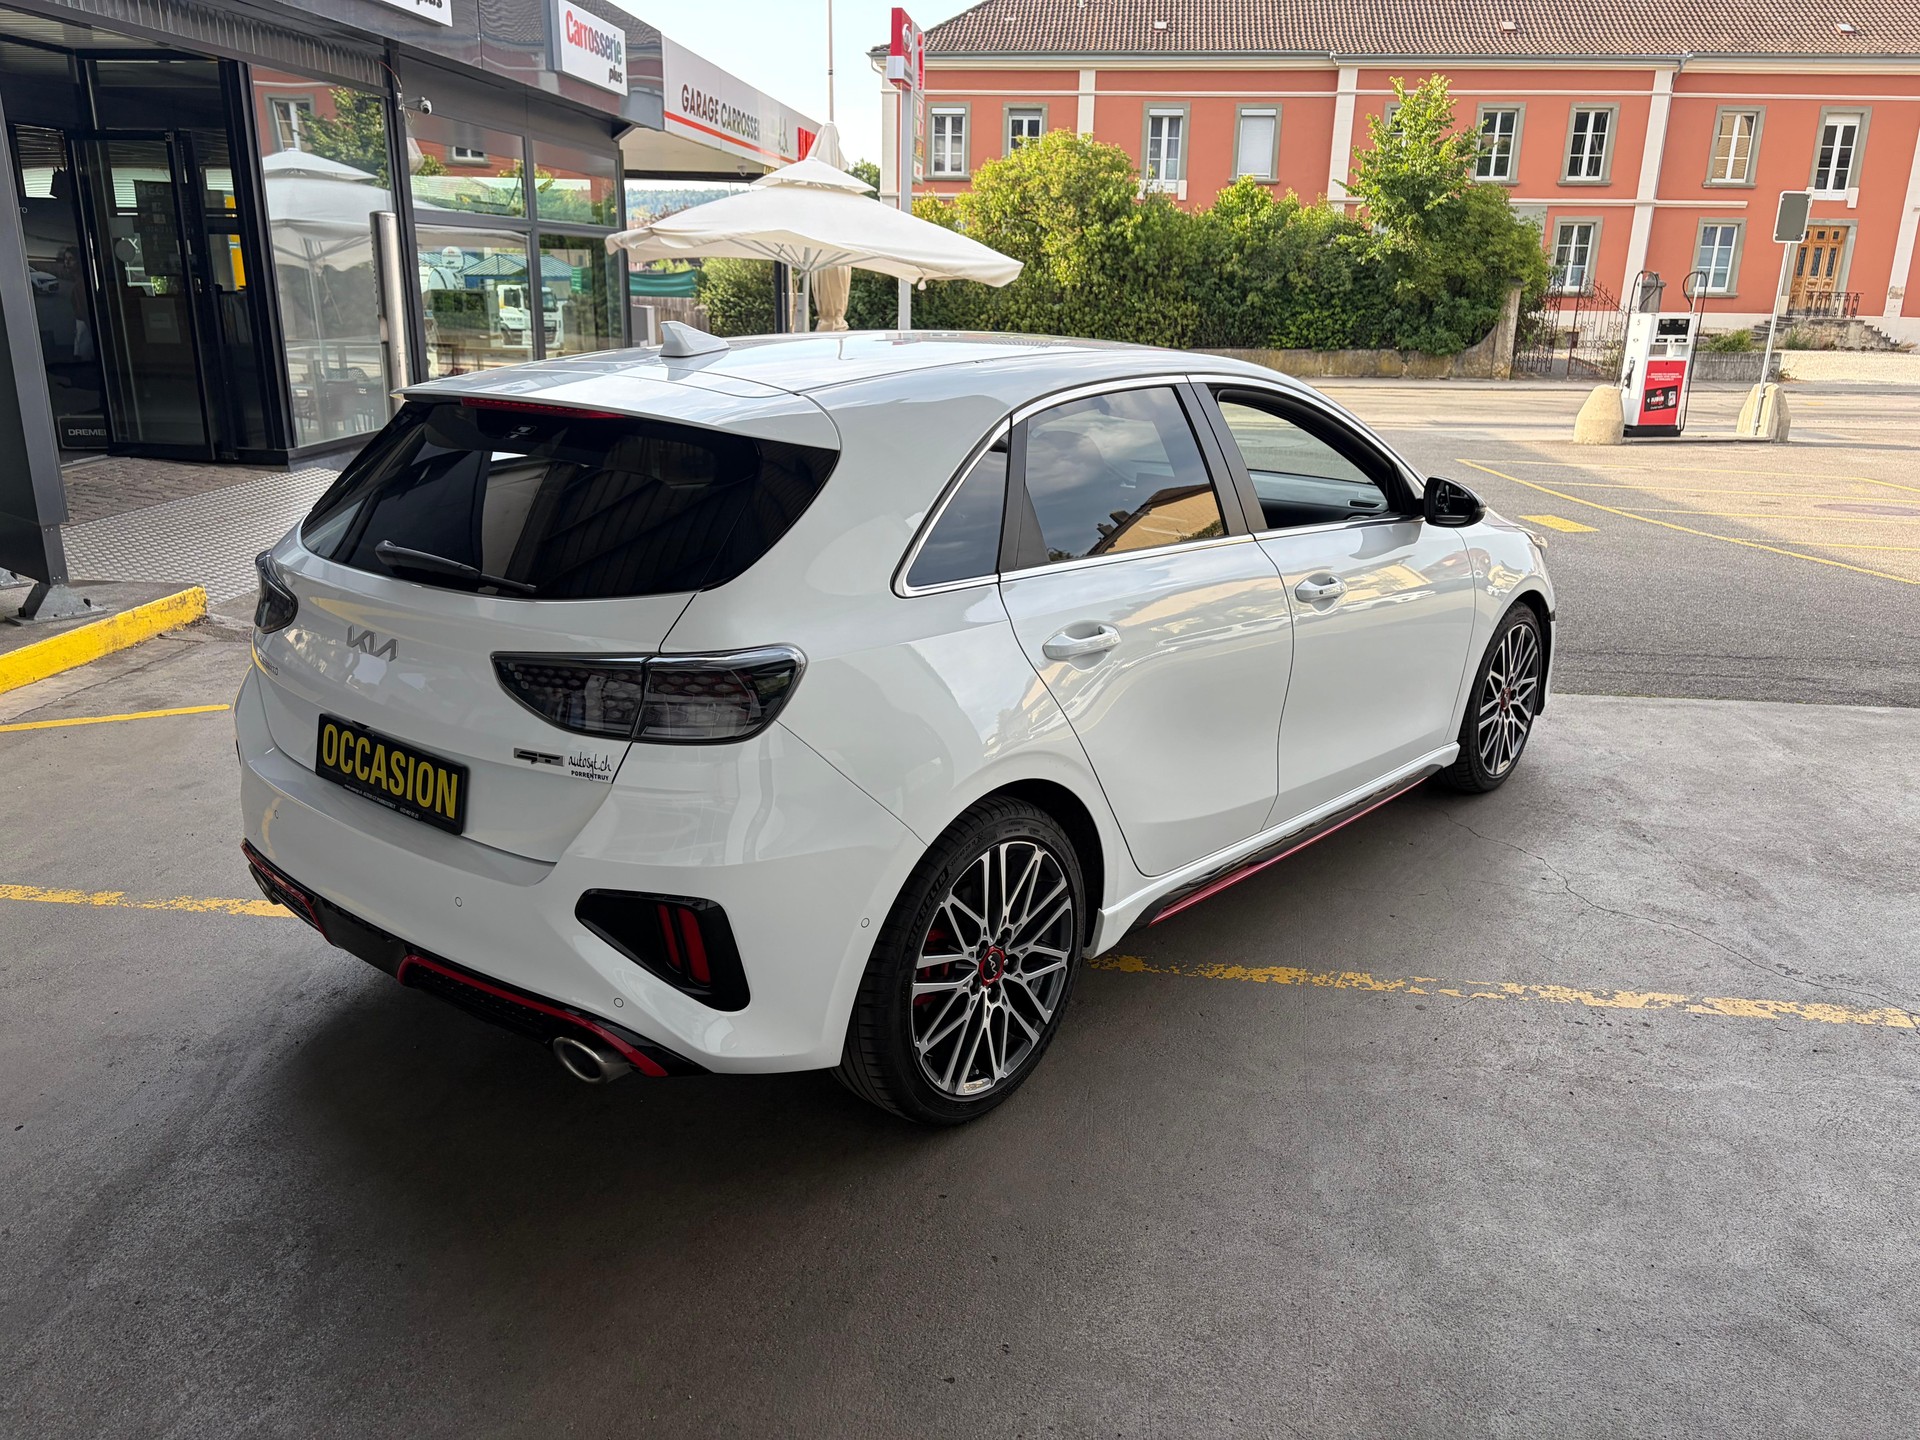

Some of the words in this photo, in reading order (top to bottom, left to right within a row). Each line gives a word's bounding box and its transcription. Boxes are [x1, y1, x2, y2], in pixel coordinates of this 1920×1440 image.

[566, 9, 623, 66] Carrosserie
[608, 65, 623, 84] plus
[681, 84, 719, 125] GARAGE
[346, 625, 398, 662] KIA
[322, 723, 458, 819] OCCASION
[571, 769, 609, 781] PORRENTRUY
